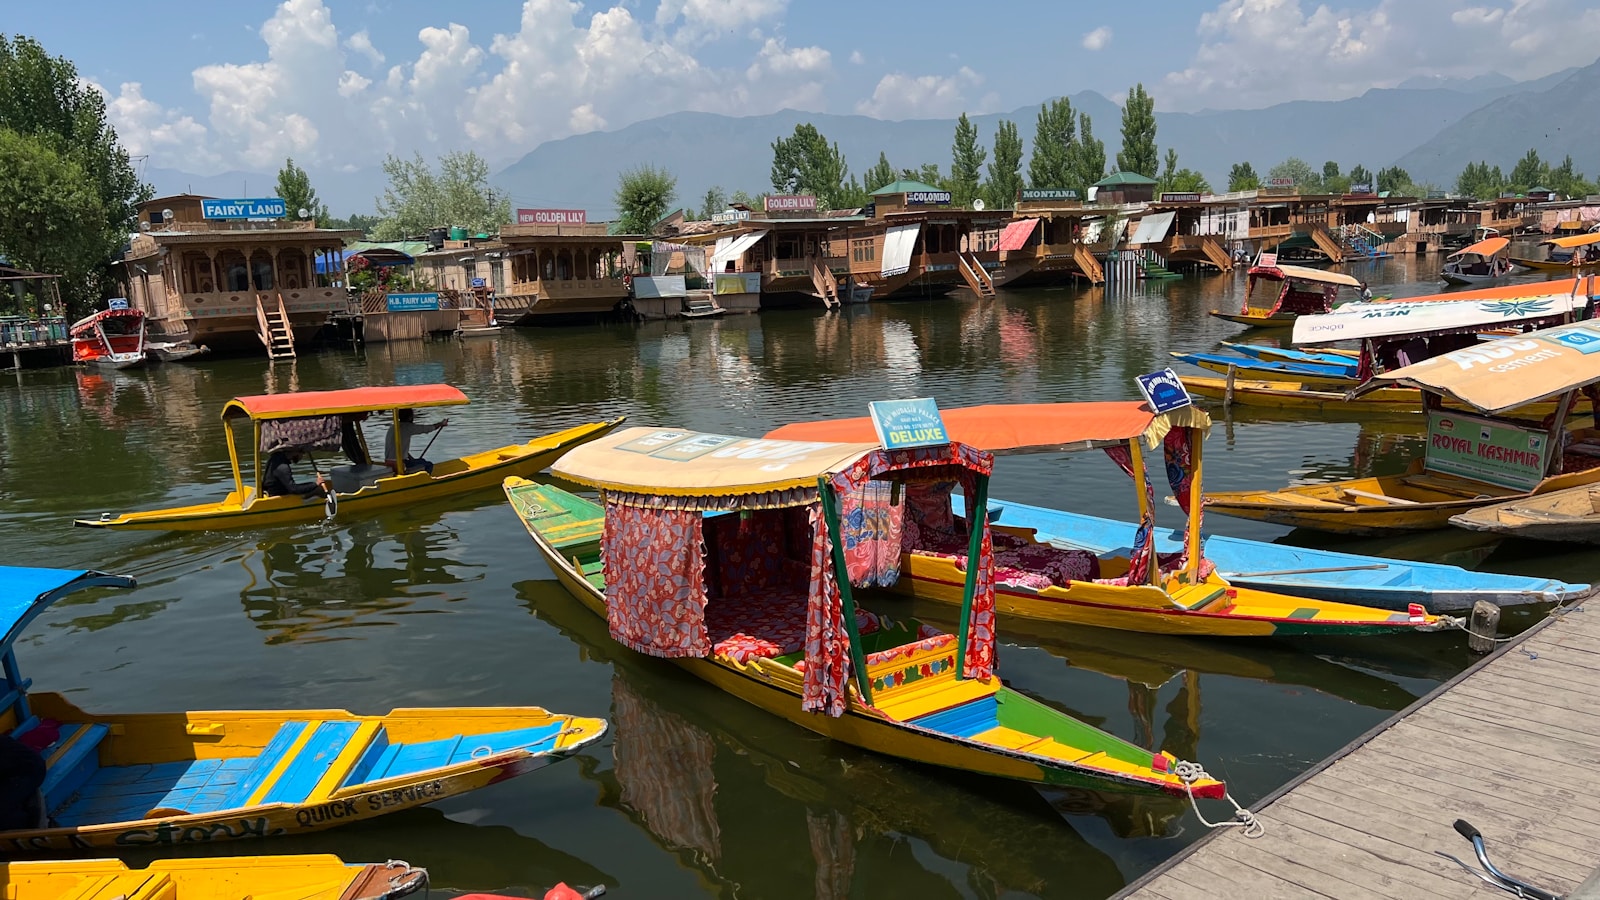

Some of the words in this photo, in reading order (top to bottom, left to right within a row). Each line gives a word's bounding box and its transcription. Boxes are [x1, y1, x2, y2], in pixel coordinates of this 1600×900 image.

[913, 192, 951, 202] COLOMBO
[1022, 190, 1077, 198] MONTANA
[768, 199, 798, 209] GOLDEN
[799, 198, 815, 208] LILY
[207, 205, 245, 216] FAIRY
[248, 204, 283, 215] LAND
[520, 214, 534, 222] NEW
[535, 212, 567, 222] GOLDEN
[568, 212, 584, 223] LILY
[713, 214, 734, 222] GOLDEN
[735, 212, 747, 220] LILY
[389, 297, 402, 305] H.B.
[402, 297, 420, 305] FAIRY
[420, 296, 437, 304] LAND
[1362, 309, 1411, 319] NEW
[1446, 339, 1540, 371] ACC
[1487, 347, 1563, 373] cement
[918, 408, 940, 425] PALACE
[889, 428, 944, 444] DELUXE
[1432, 433, 1474, 455] ROYAL
[1477, 442, 1540, 470] KASHMIR
[295, 801, 359, 828] QUICK
[367, 779, 446, 811] SERVICE
